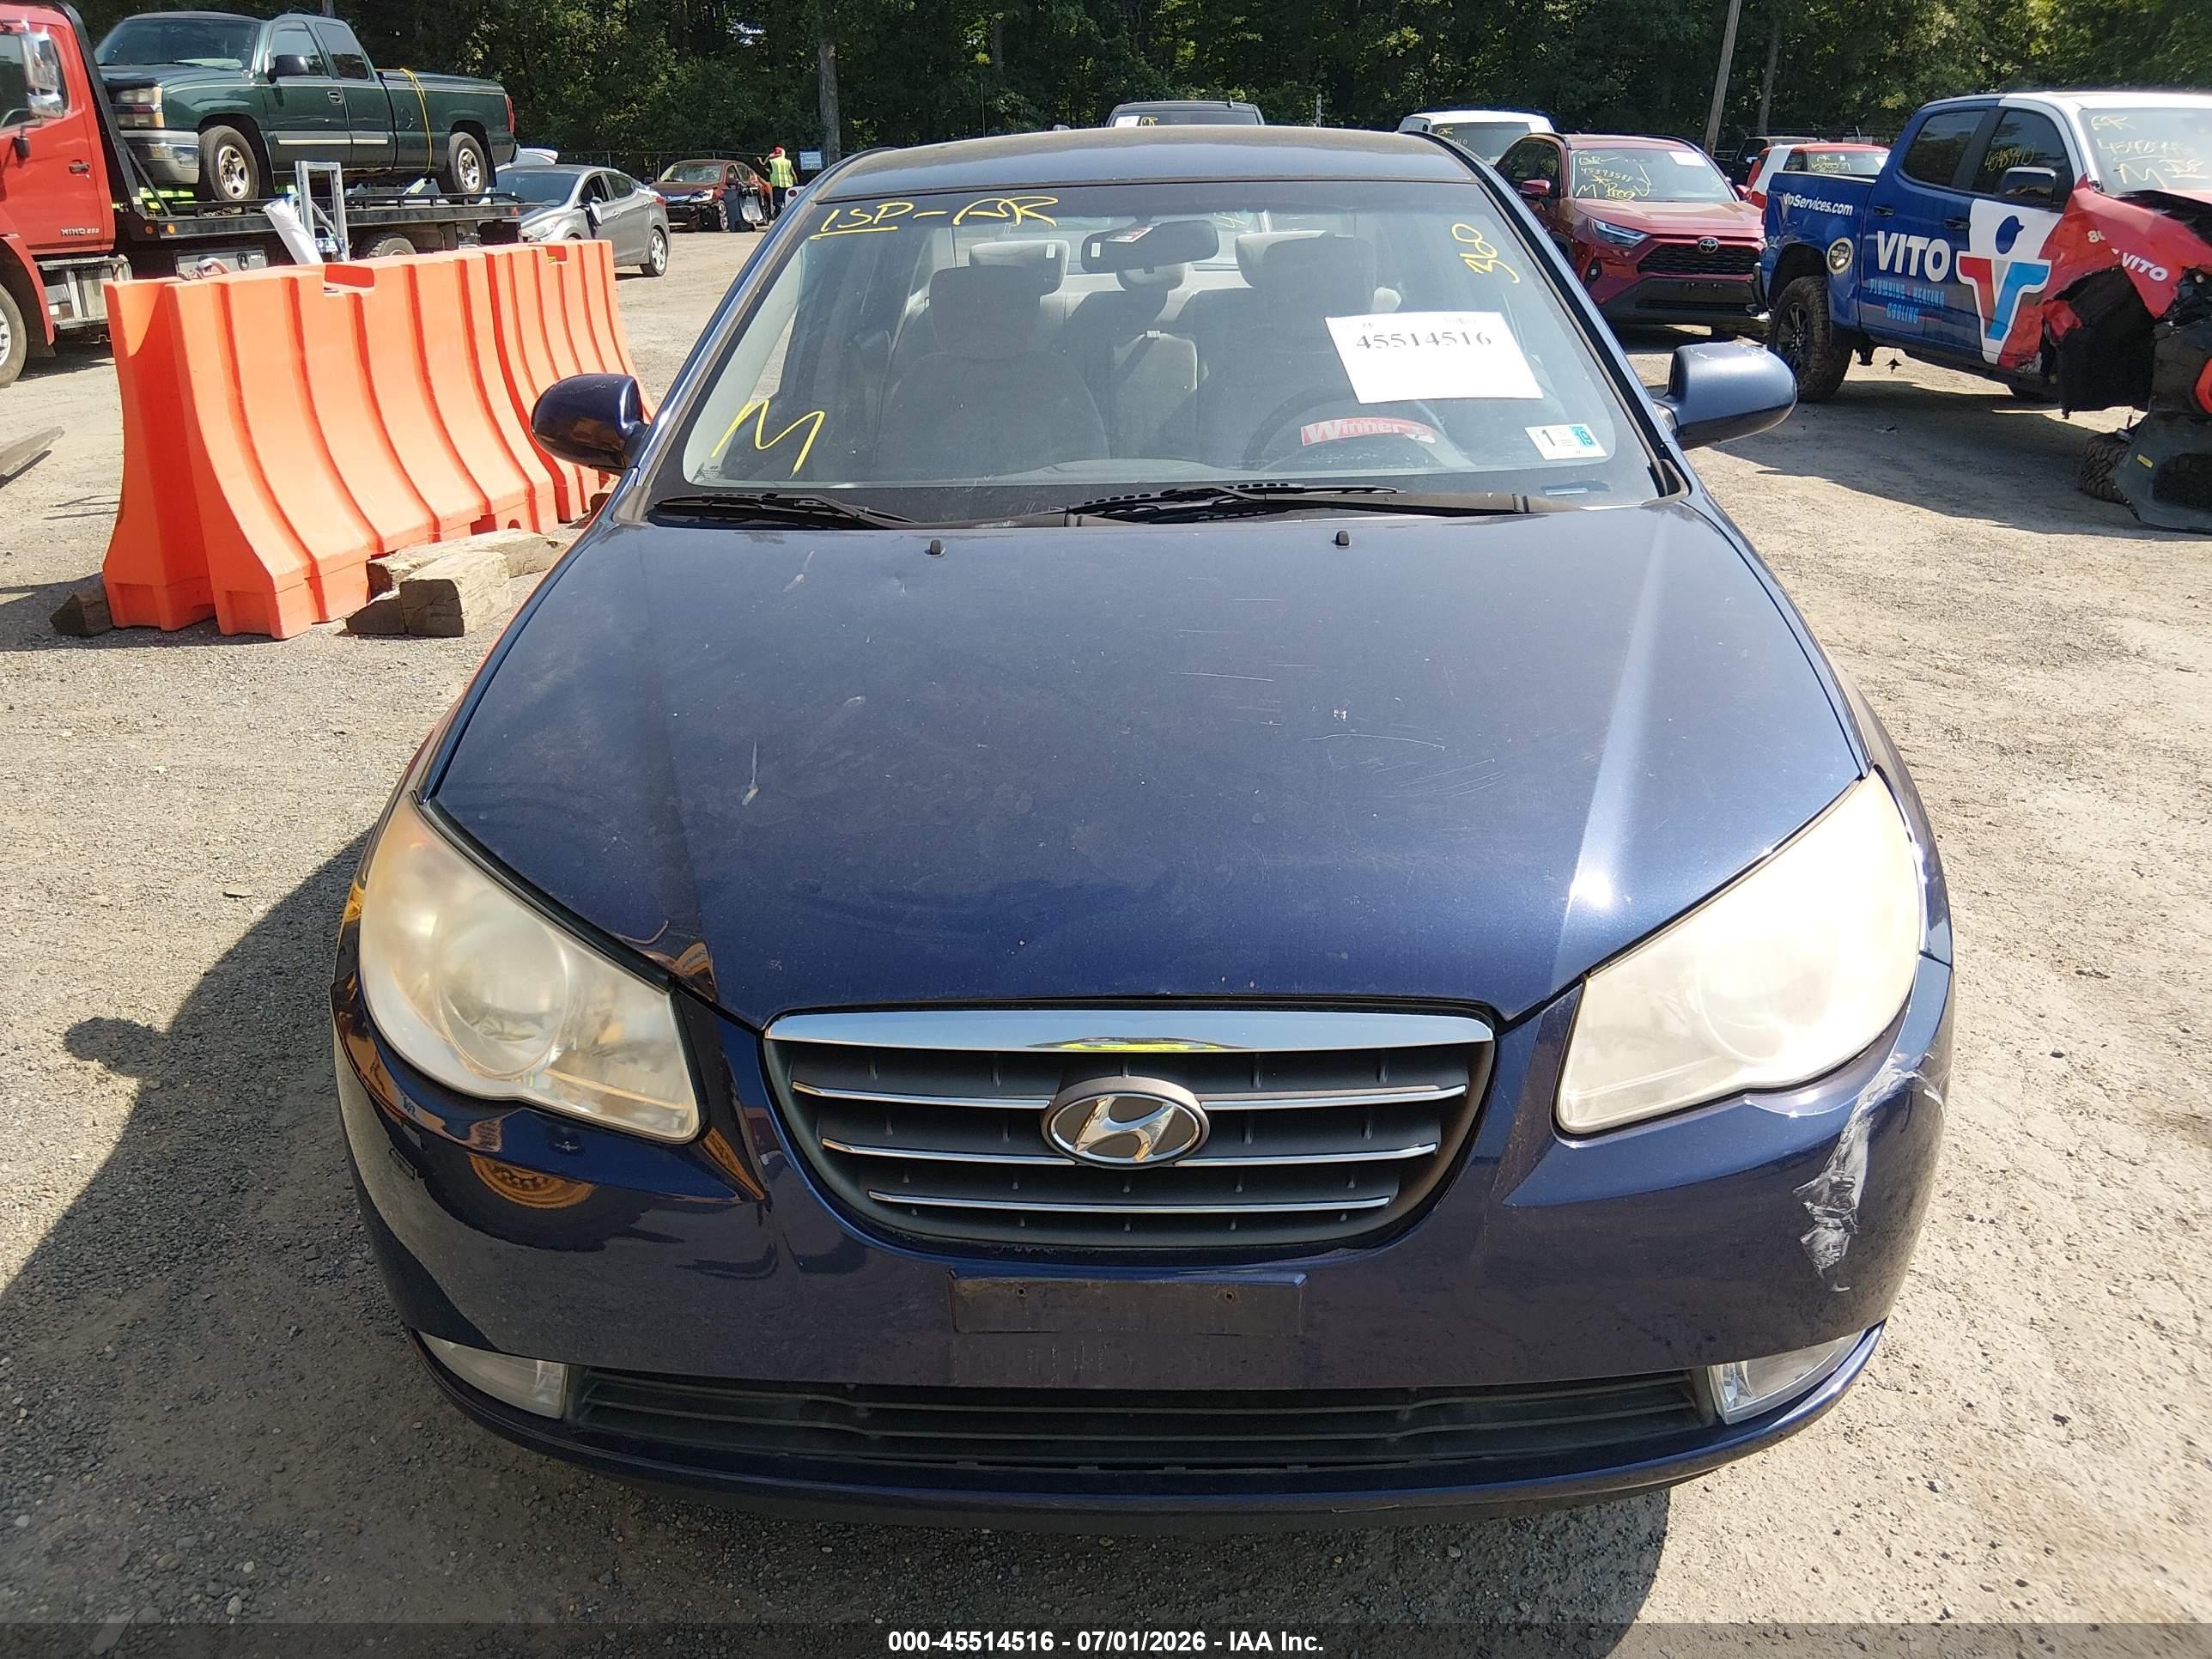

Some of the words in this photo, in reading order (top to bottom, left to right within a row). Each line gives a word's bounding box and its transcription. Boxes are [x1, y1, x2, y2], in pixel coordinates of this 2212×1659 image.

[1876, 230, 1951, 283] VITO
[2122, 252, 2168, 282] VITO
[1355, 331, 1492, 349] 45514516
[709, 398, 826, 480] M
